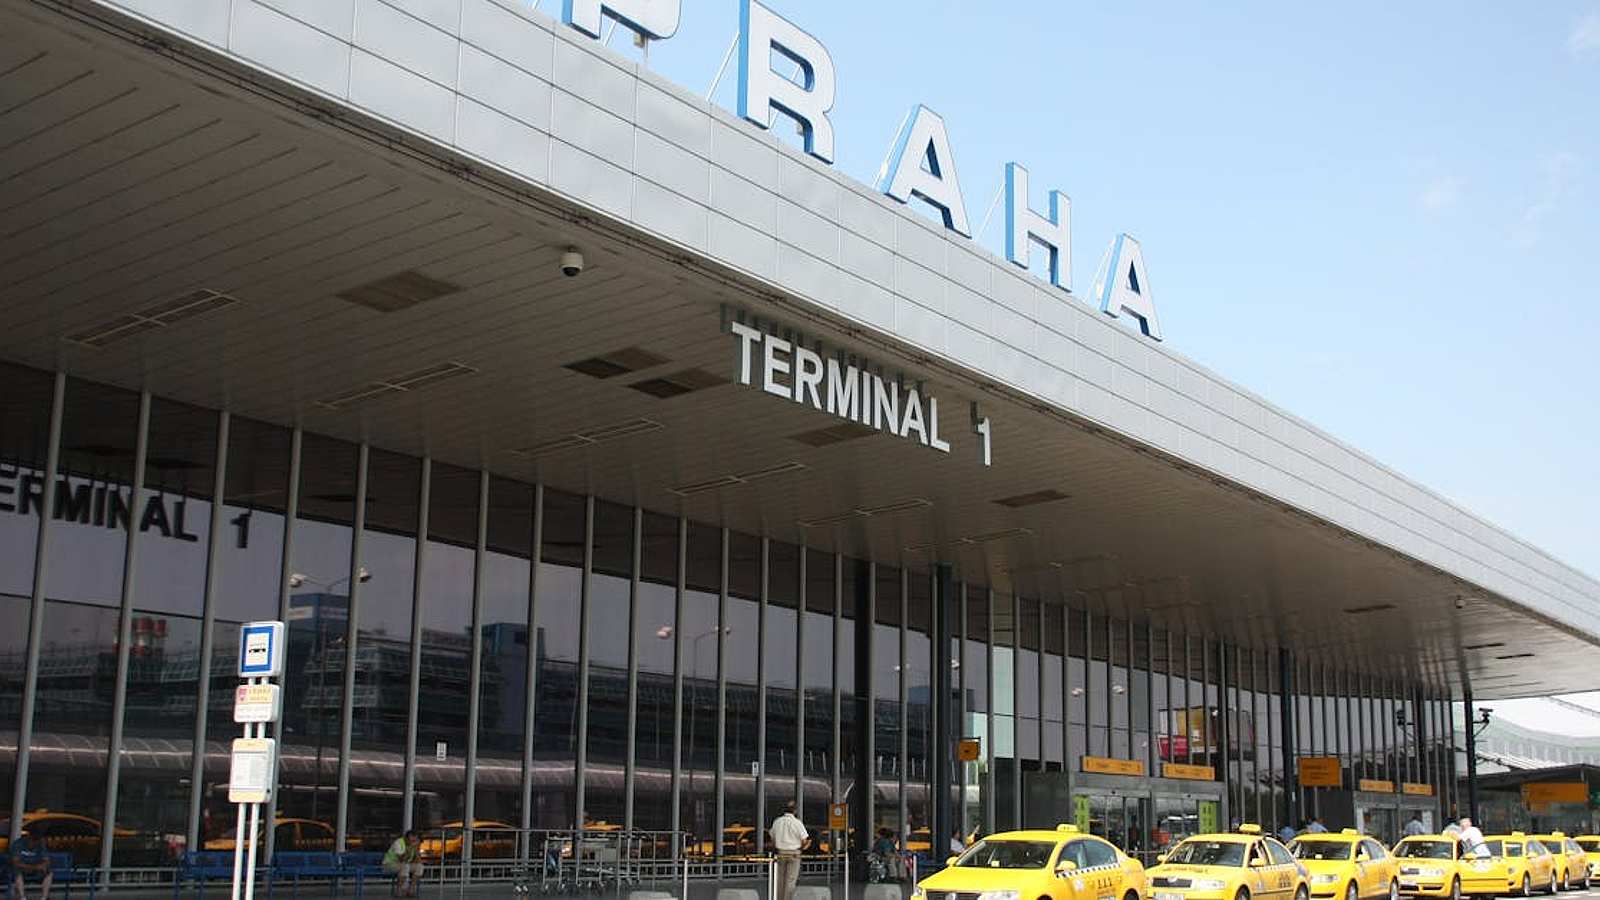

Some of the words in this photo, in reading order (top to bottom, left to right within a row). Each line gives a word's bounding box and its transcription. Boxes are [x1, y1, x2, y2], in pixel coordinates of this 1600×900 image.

[563, 0, 1162, 340] RAHA
[731, 321, 950, 453] TERMINAL
[977, 416, 992, 466] 1
[230, 511, 251, 549] 1
